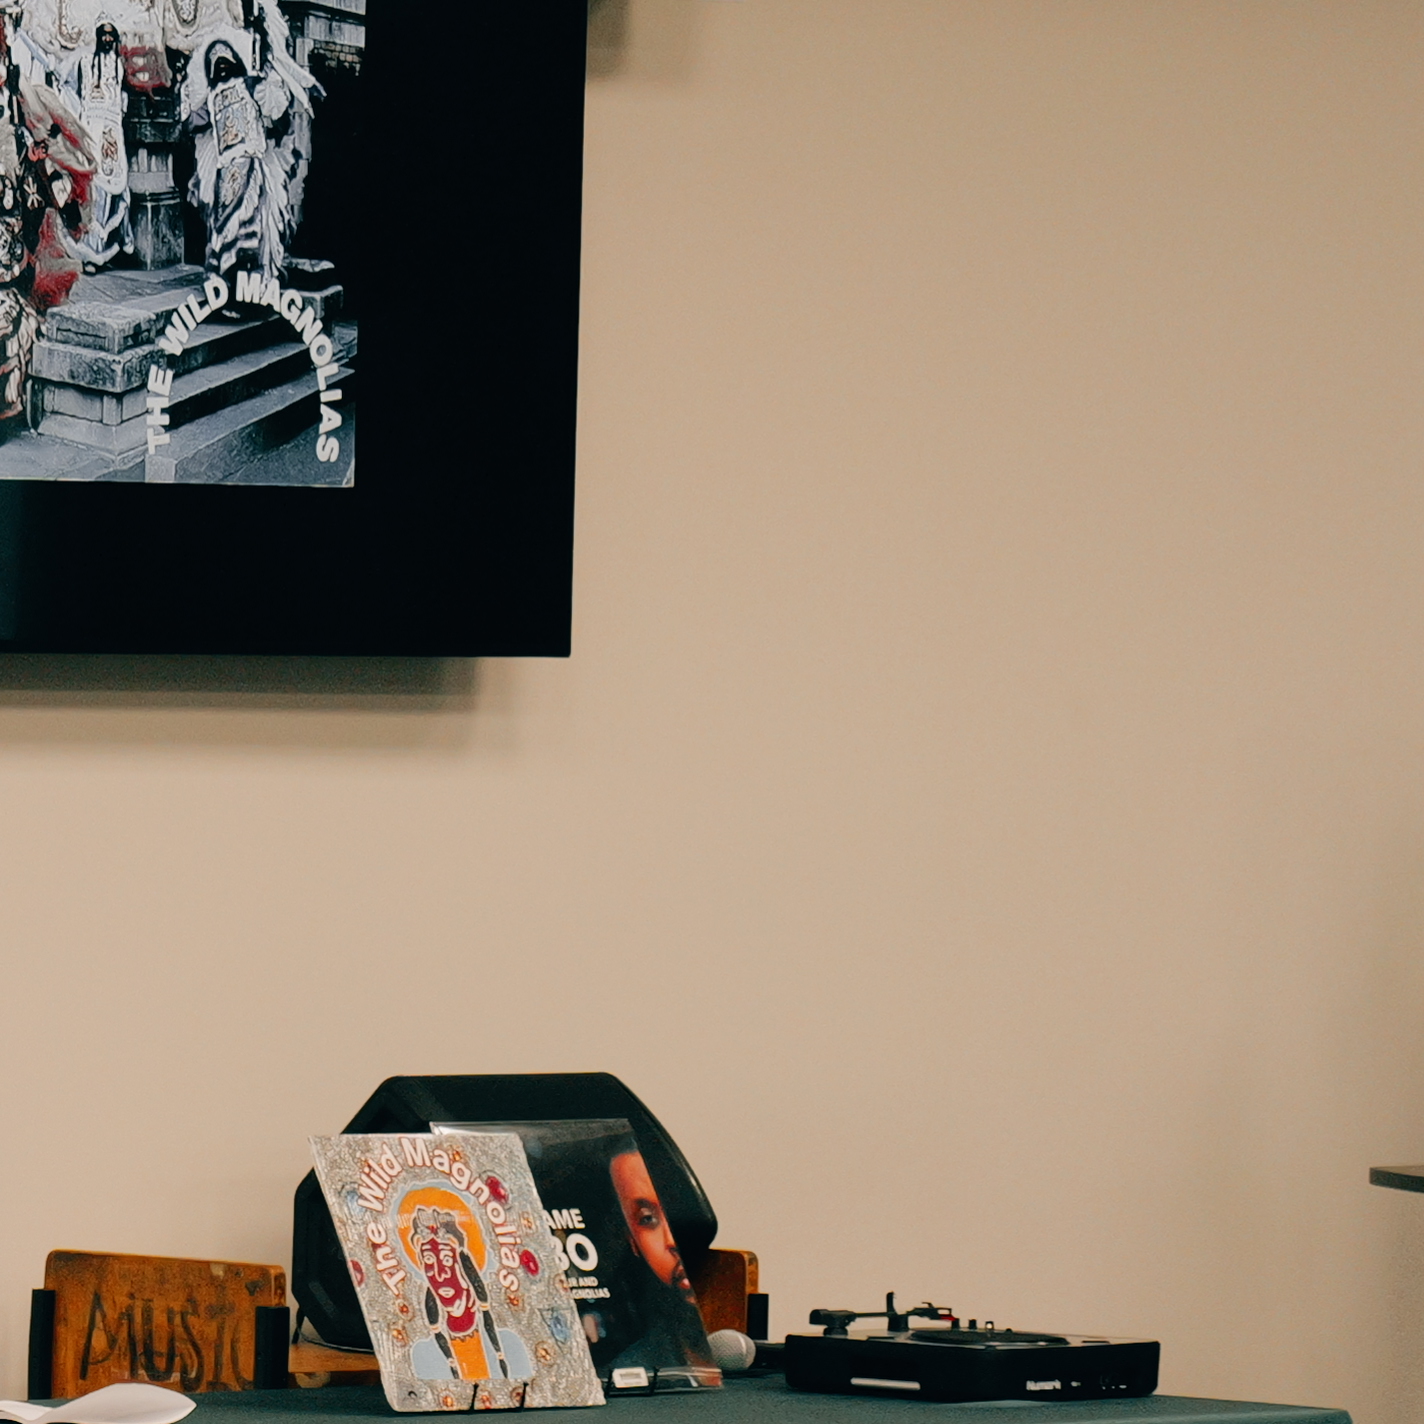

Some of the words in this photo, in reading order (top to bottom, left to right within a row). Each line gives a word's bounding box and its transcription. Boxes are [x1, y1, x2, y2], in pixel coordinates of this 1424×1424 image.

[159, 274, 229, 357] WILD
[236, 270, 343, 463] MAGNOLIAS
[146, 364, 174, 454] THE
[357, 1143, 403, 1214] Wild
[401, 1138, 522, 1293] Magnolias
[541, 1208, 586, 1230] AME
[366, 1221, 407, 1297] The
